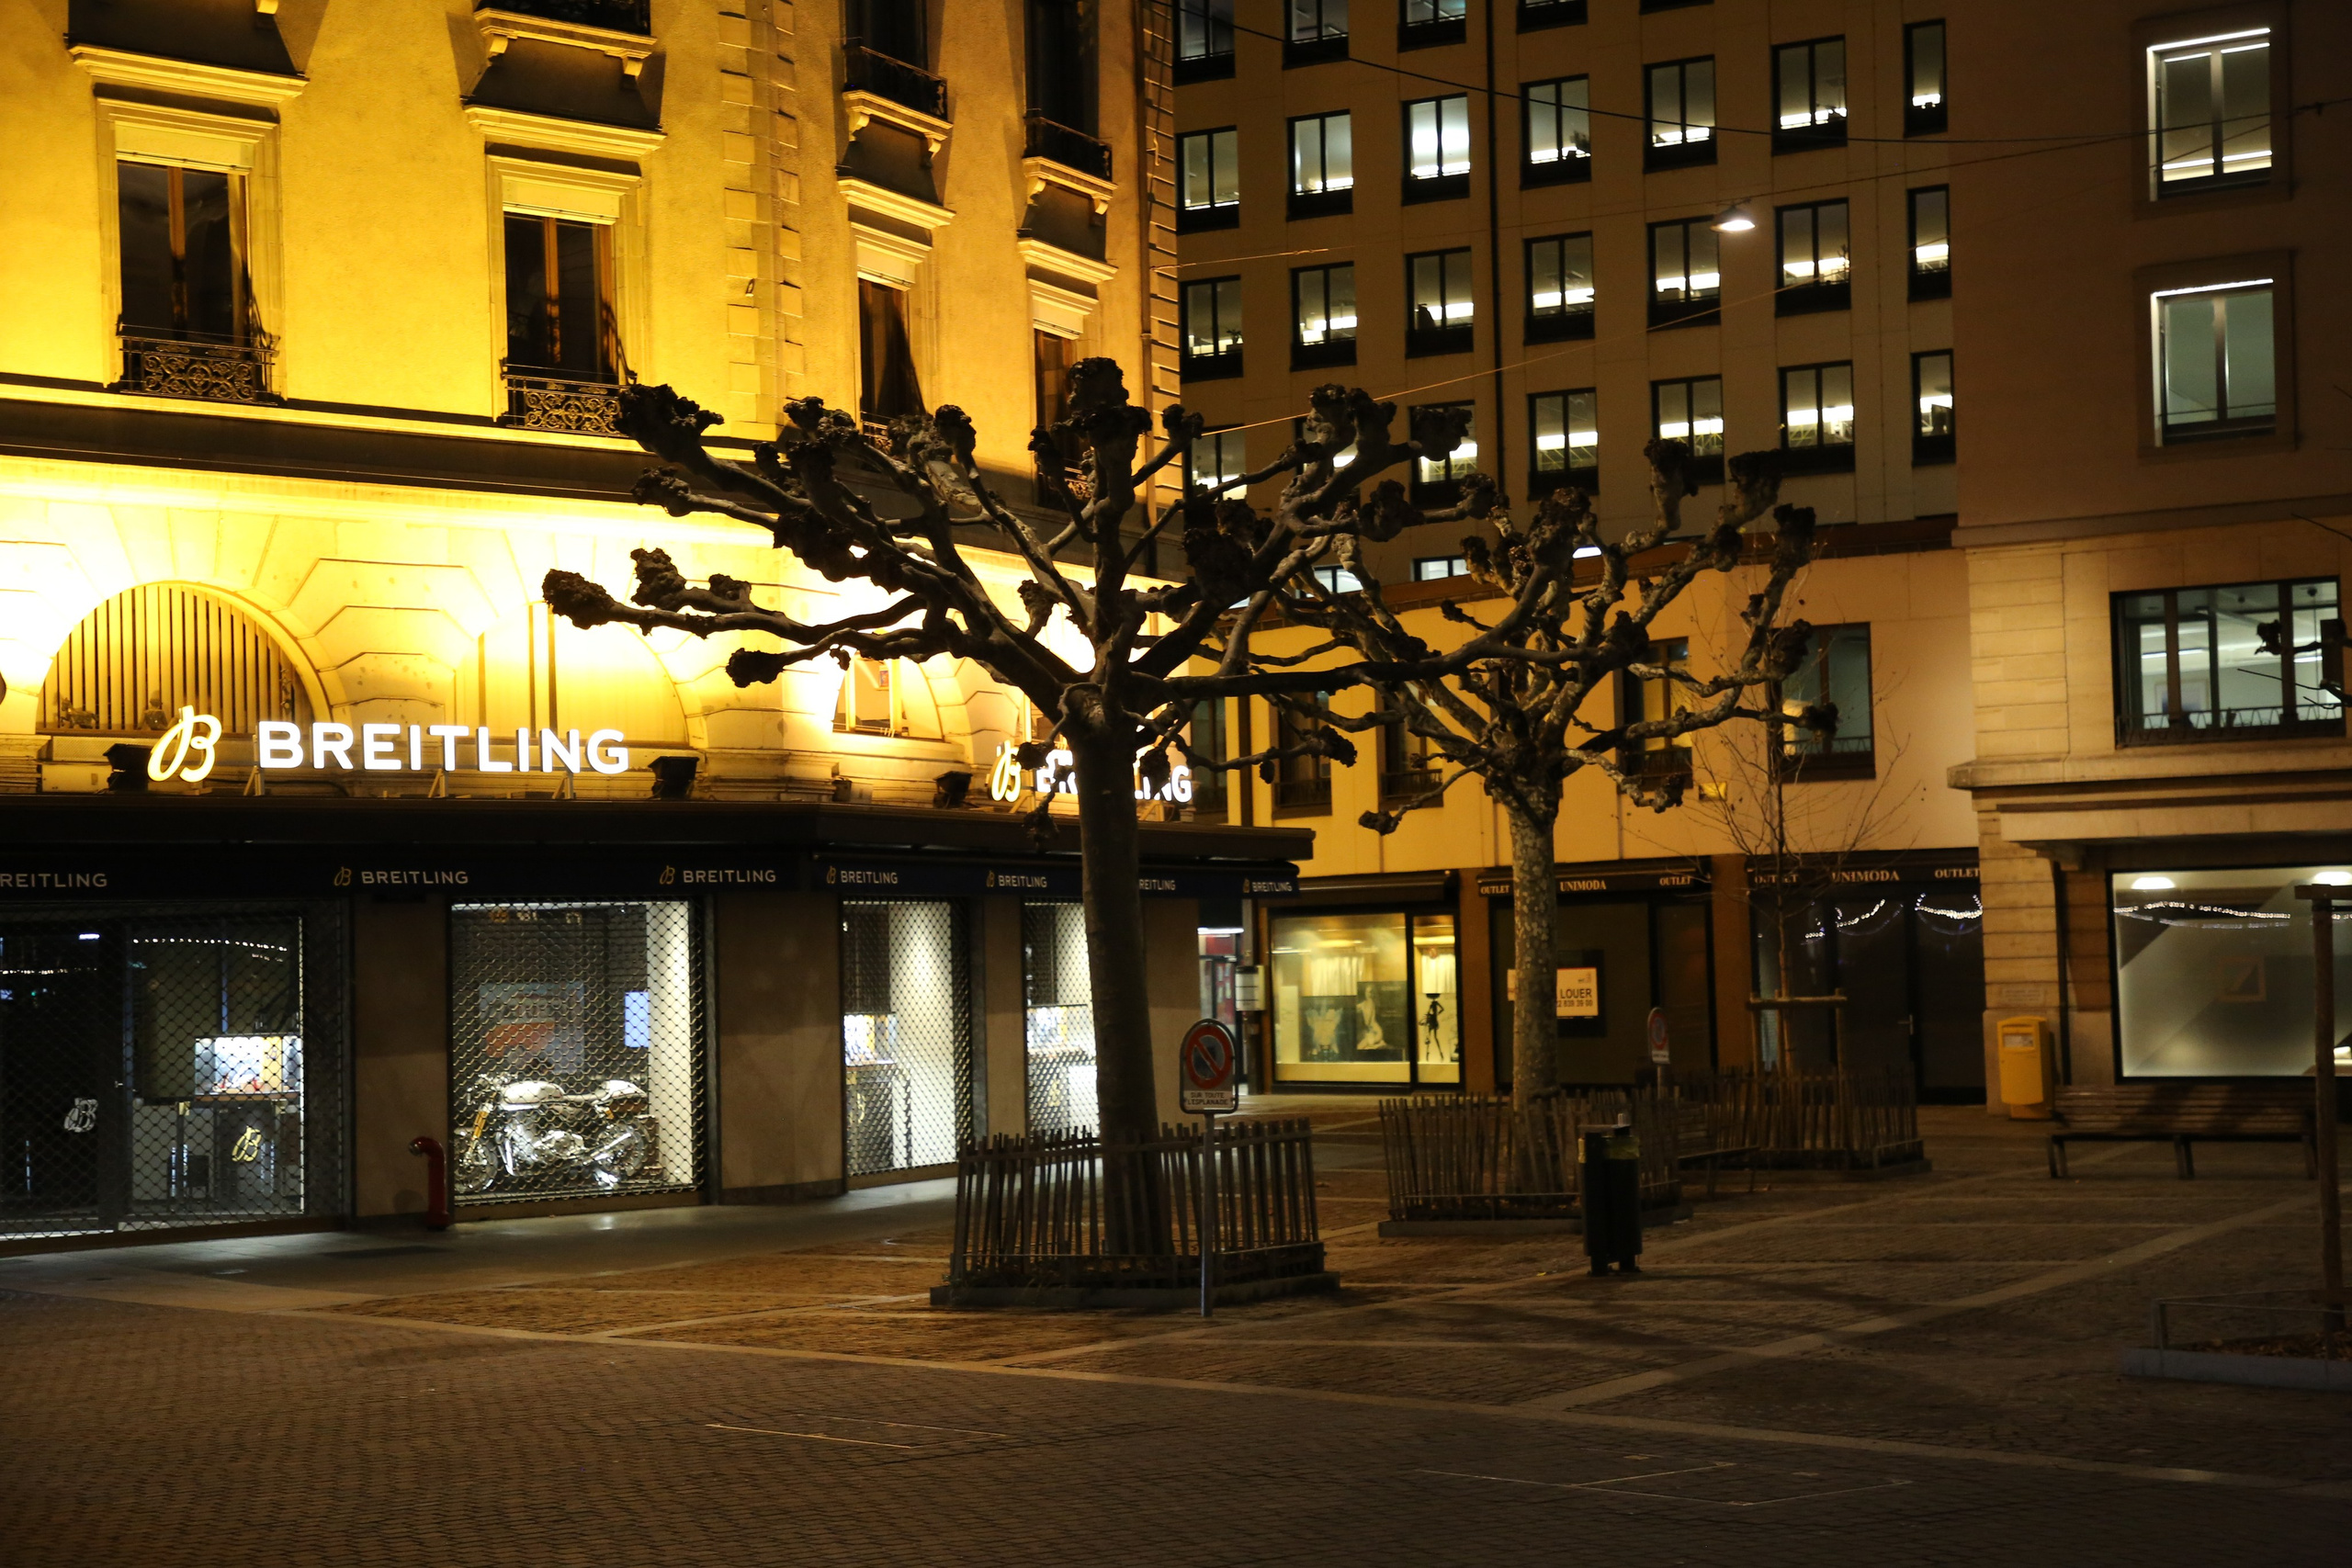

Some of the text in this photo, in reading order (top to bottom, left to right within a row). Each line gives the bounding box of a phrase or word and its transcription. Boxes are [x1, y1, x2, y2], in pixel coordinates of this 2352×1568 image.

[258, 720, 629, 774] BREITLING
[361, 870, 469, 885] BREITLING
[683, 869, 776, 884] BREITLING
[840, 870, 899, 885] BREITLING
[1831, 870, 1900, 883] UNIMODA
[1934, 867, 1981, 879] OUTLET
[0, 873, 108, 888] REITLING
[998, 874, 1047, 888] BREITLING
[1138, 878, 1177, 891] REITLING
[1251, 881, 1294, 893] BREITLING
[1559, 879, 1607, 892] UNIMODA
[1658, 875, 1690, 886] OUTLET
[1480, 885, 1510, 895] OUTLET
[1560, 988, 1593, 999] LOUER
